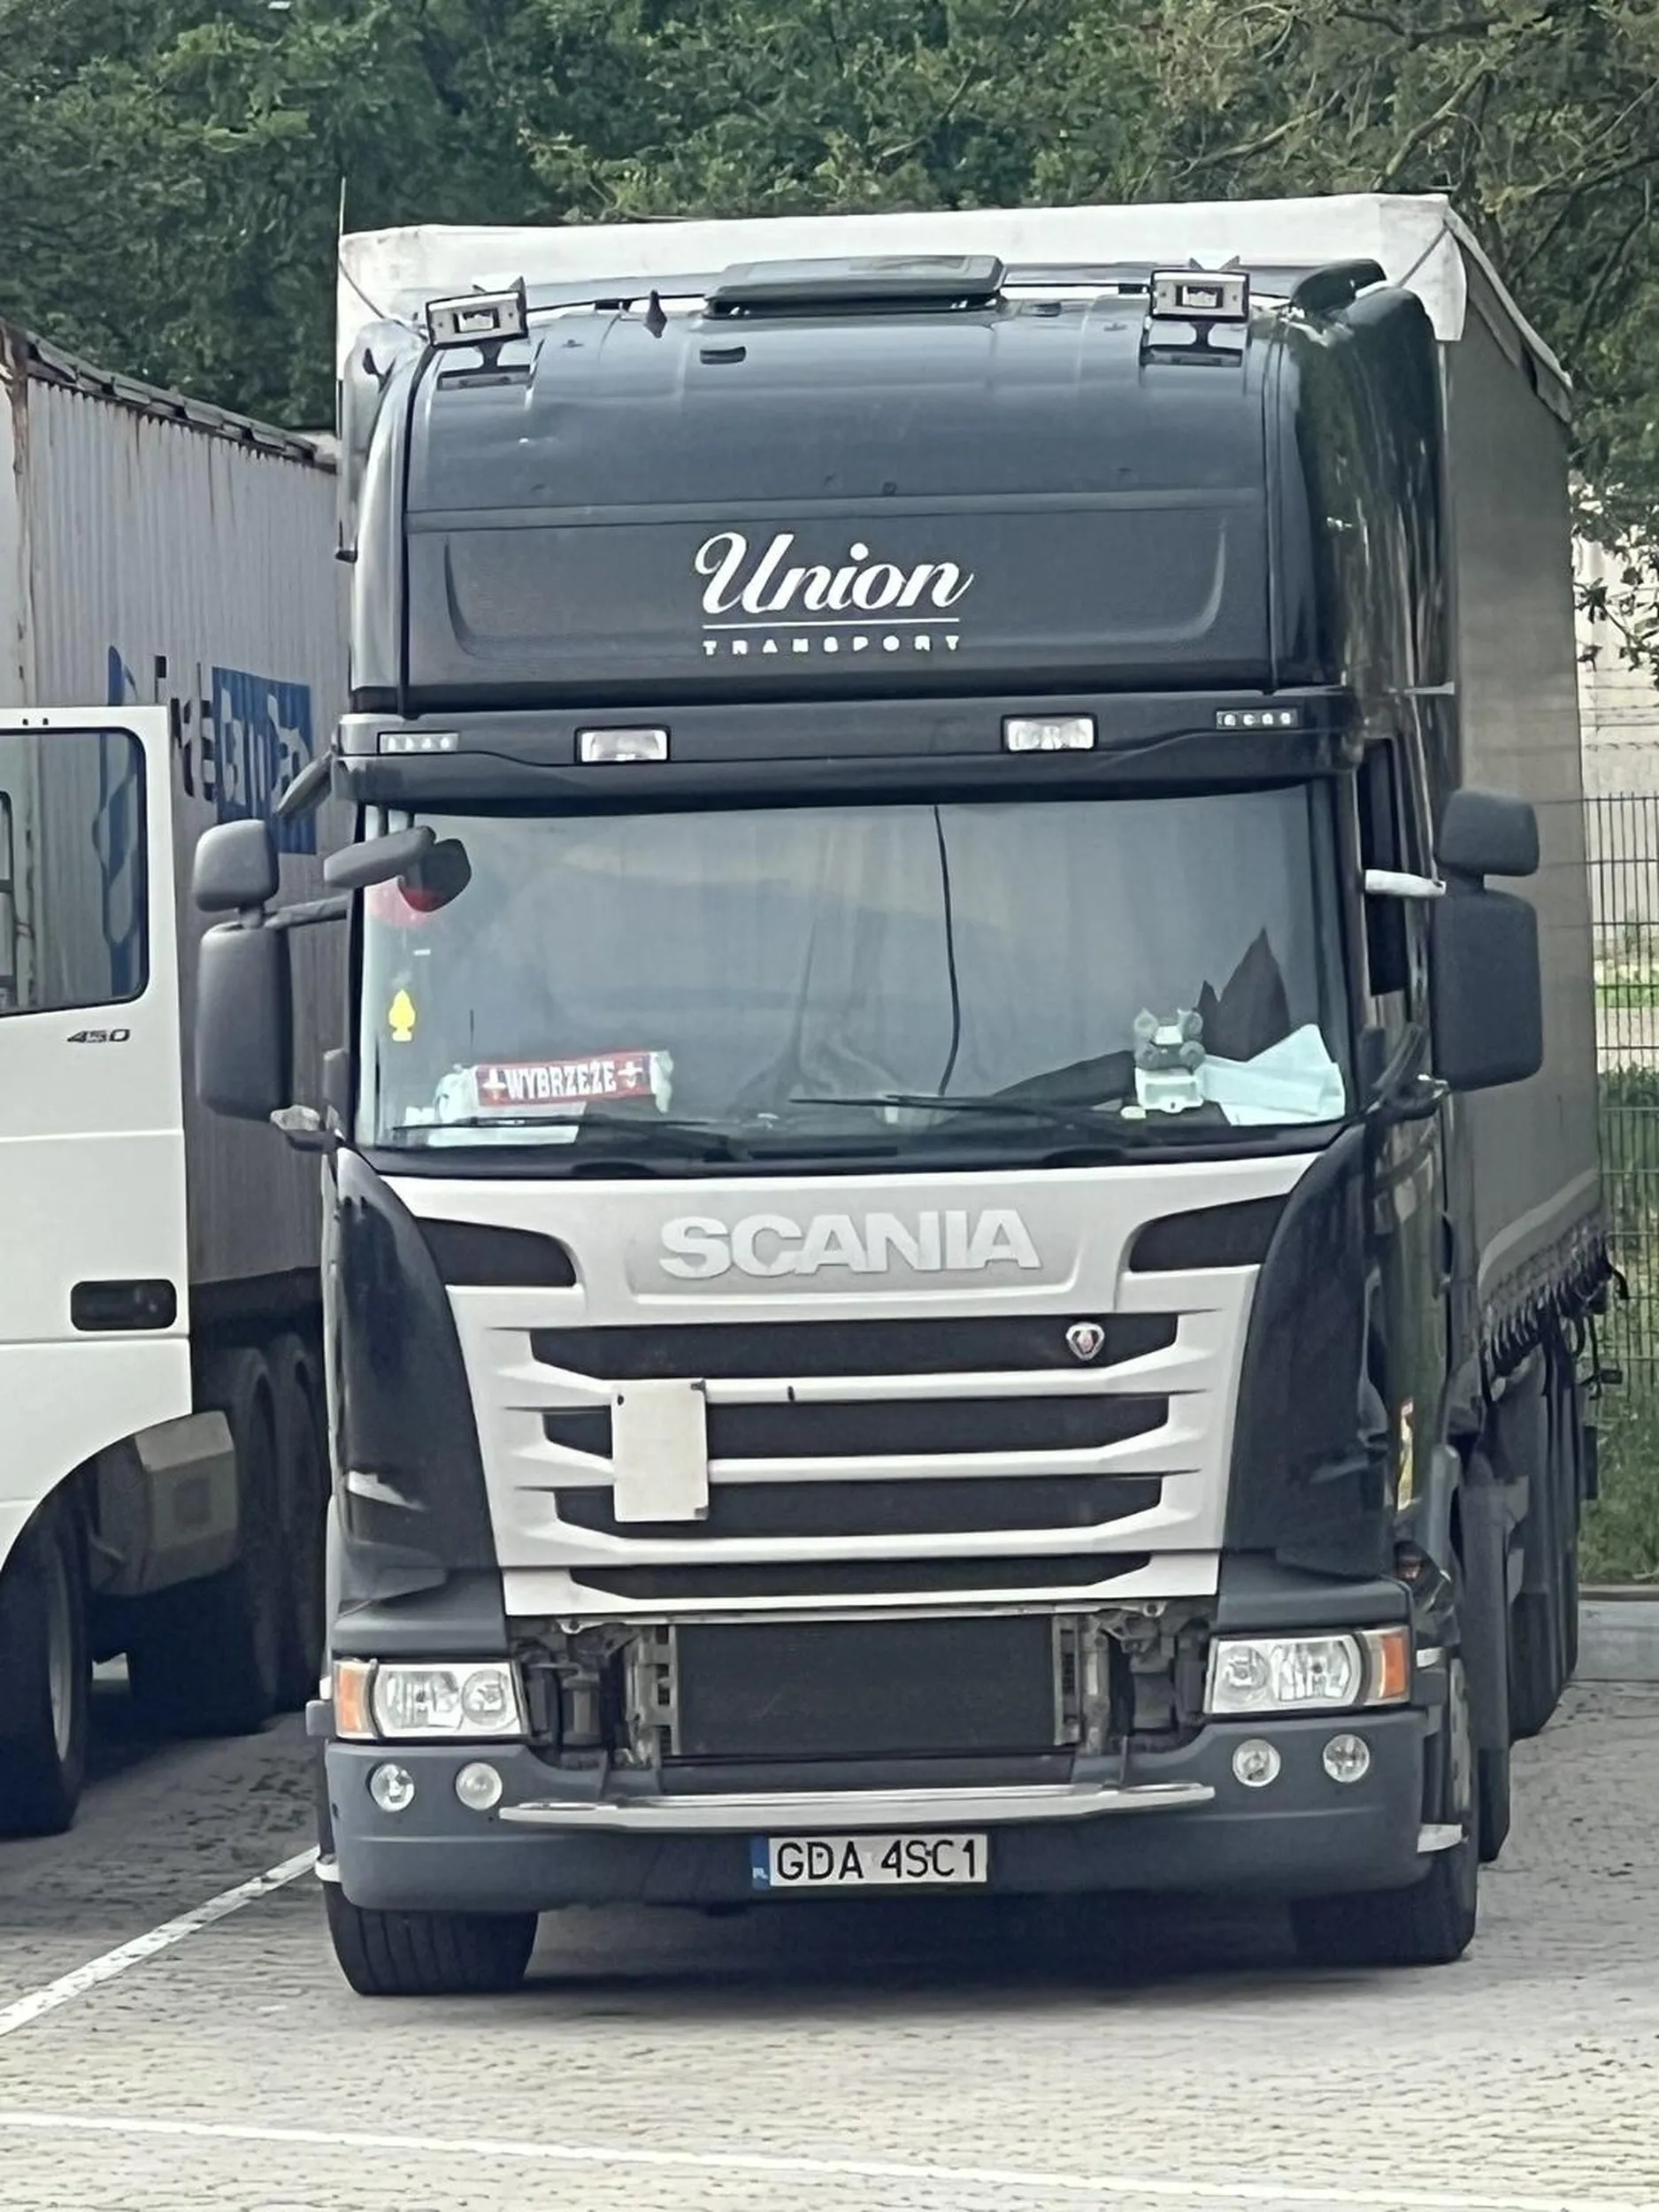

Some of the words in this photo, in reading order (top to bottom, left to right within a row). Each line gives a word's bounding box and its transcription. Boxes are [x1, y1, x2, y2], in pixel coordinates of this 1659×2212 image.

[695, 532, 973, 614] Union
[703, 634, 960, 656] TRANSPORT
[67, 1029, 130, 1043] 450
[659, 1210, 1042, 1279] SCANIA
[777, 1840, 864, 1880] GDA
[880, 1839, 976, 1878] 4SC1
